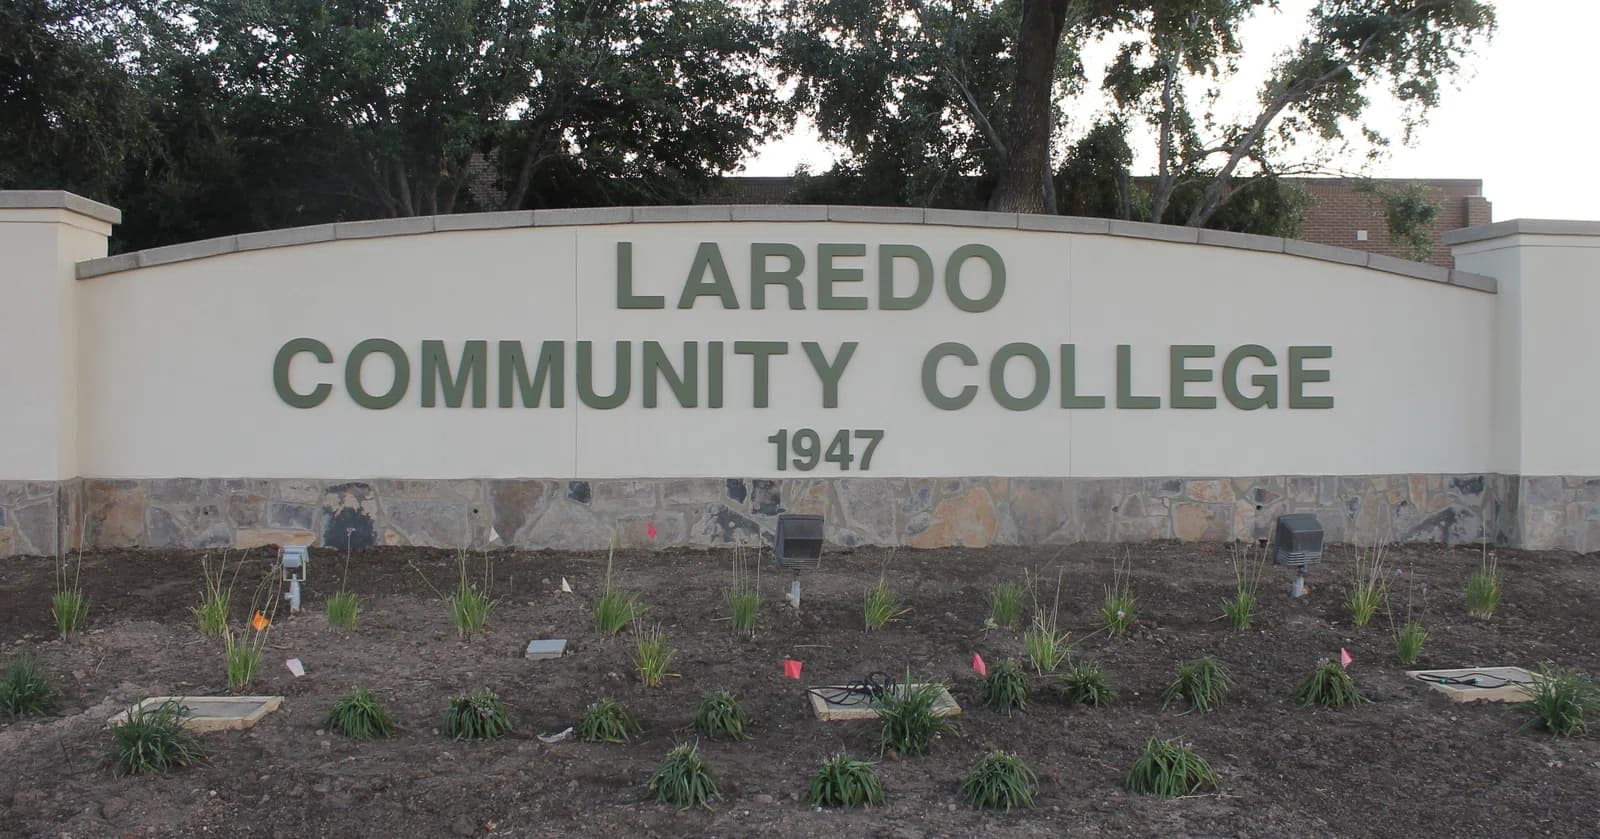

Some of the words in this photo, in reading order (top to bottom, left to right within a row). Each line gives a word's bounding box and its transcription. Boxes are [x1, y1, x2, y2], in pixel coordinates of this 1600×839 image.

[615, 241, 1007, 313] LAREDO
[272, 337, 860, 411] COMMUNITY
[921, 341, 1335, 412] COLLEGE
[767, 428, 885, 472] 1947
